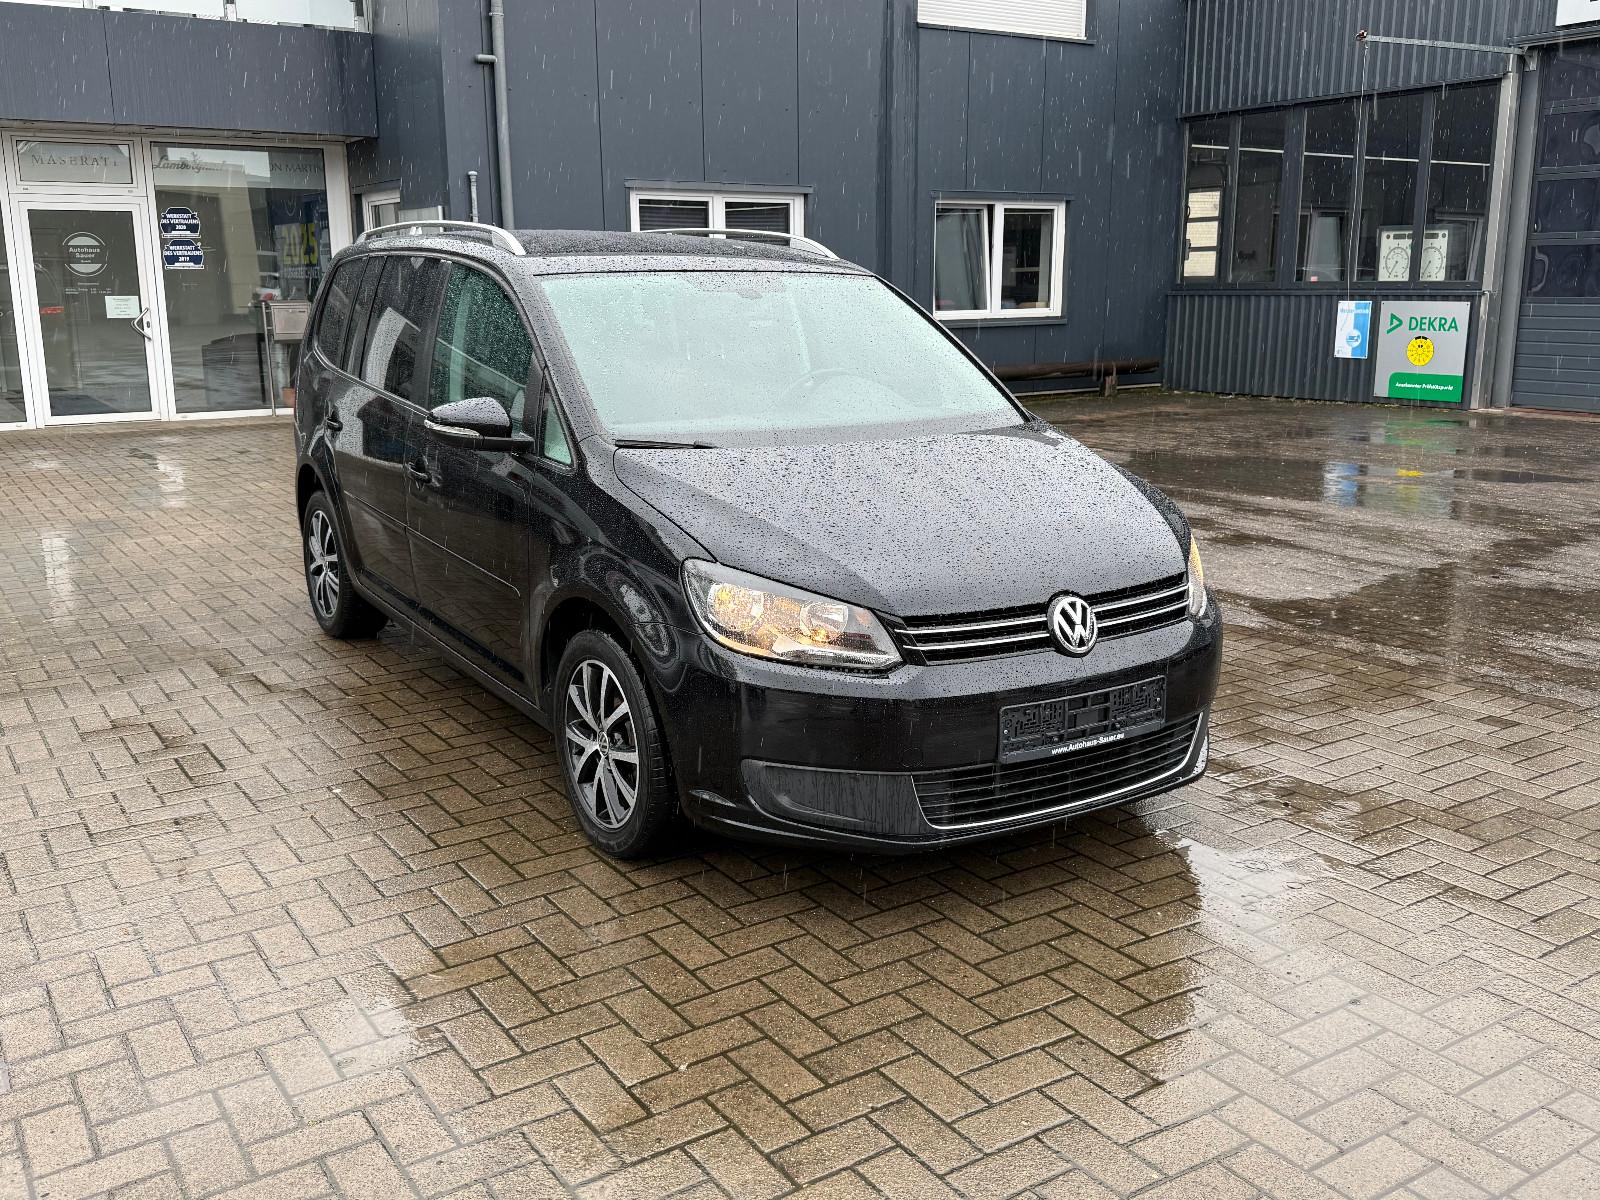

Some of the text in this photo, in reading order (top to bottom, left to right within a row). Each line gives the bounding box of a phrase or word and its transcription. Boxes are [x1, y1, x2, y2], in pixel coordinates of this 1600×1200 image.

[152, 154, 224, 174] Lamborg
[1408, 316, 1459, 332] DEKRA
[1051, 733, 1125, 755] www.Autohaus-Sauer.eu
